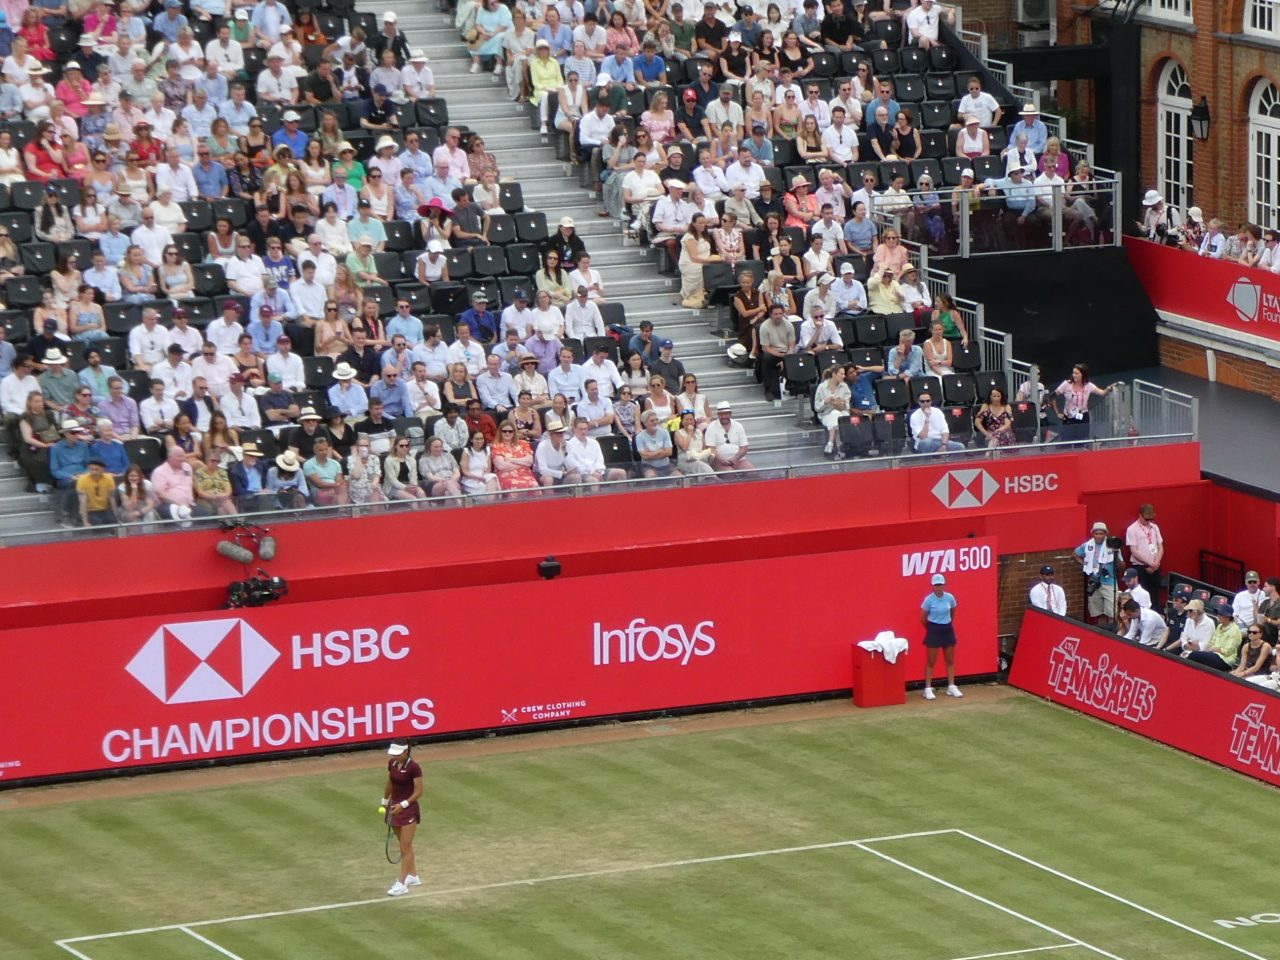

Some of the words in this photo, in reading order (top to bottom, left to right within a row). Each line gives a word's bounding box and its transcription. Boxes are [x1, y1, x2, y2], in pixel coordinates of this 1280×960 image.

[1262, 293, 1280, 312] LTA
[1004, 473, 1058, 494] HSBC
[902, 549, 956, 577] WTA
[959, 545, 991, 571] 500
[291, 624, 410, 669] HSBC
[593, 618, 716, 666] Infosys
[521, 704, 544, 714] CREW
[546, 700, 587, 711] CLOTHING
[532, 709, 571, 720] COMPANY
[102, 698, 436, 763] CHAMPIONSHIPS
